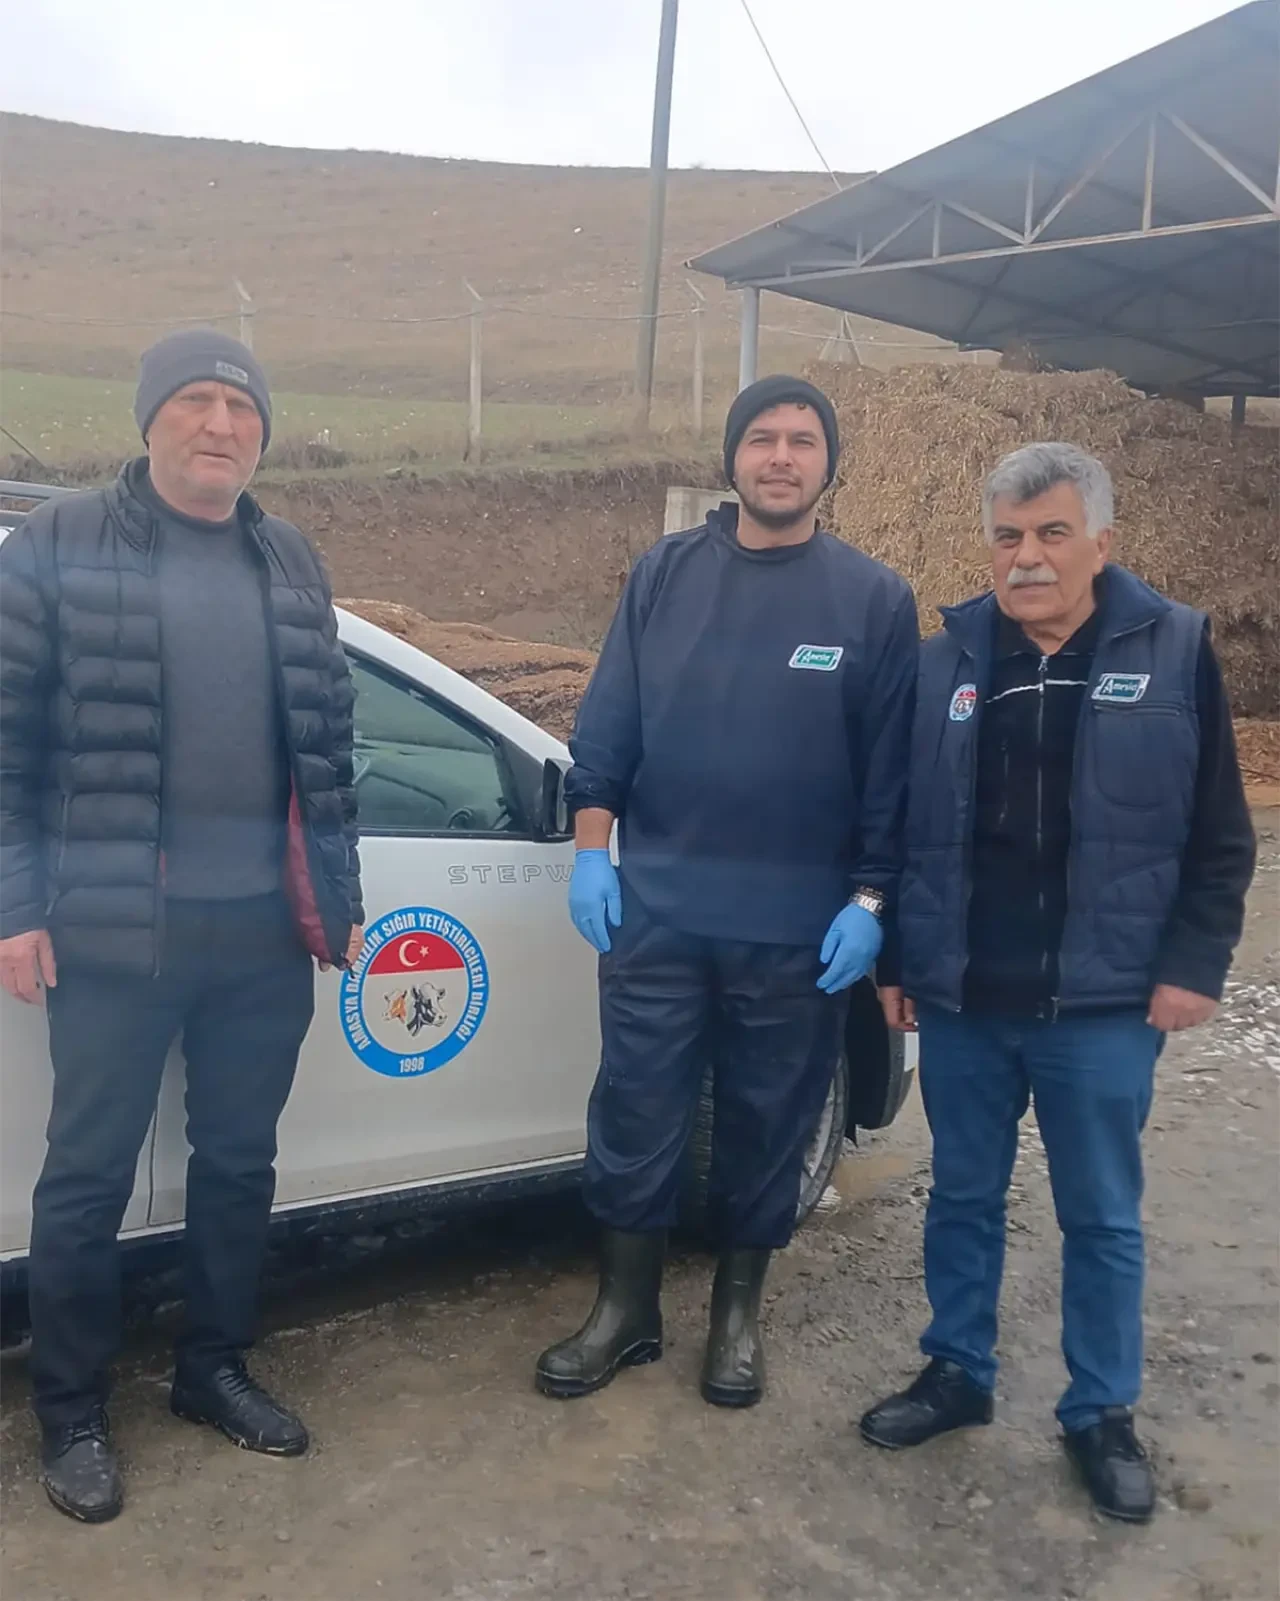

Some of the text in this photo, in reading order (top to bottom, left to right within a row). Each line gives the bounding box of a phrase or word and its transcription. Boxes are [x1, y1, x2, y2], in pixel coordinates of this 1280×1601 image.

[344, 995, 372, 1051] AMASYA
[381, 913, 417, 938] SIĞIR
[399, 1056, 426, 1074] 1998
